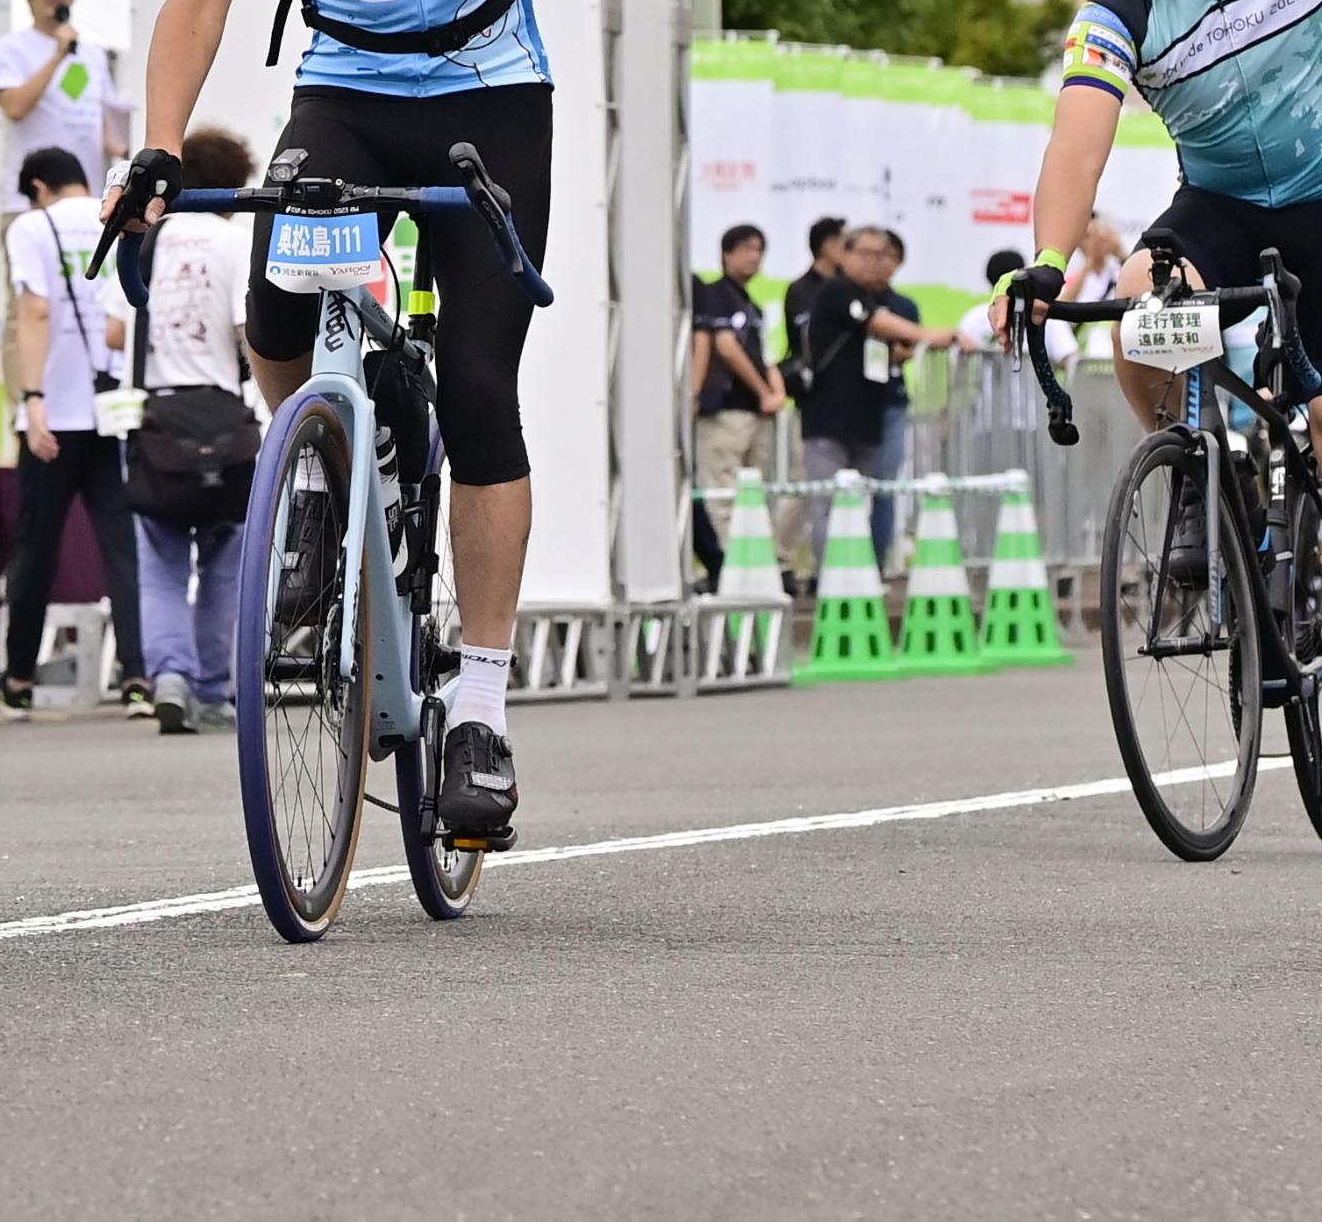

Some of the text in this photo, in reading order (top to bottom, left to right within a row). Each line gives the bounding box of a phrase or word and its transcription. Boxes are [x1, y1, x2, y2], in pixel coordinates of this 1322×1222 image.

[277, 223, 362, 258] 奥松島111
[1138, 311, 1202, 329] 走行管理
[1138, 331, 1200, 347] 遠藤 友和
